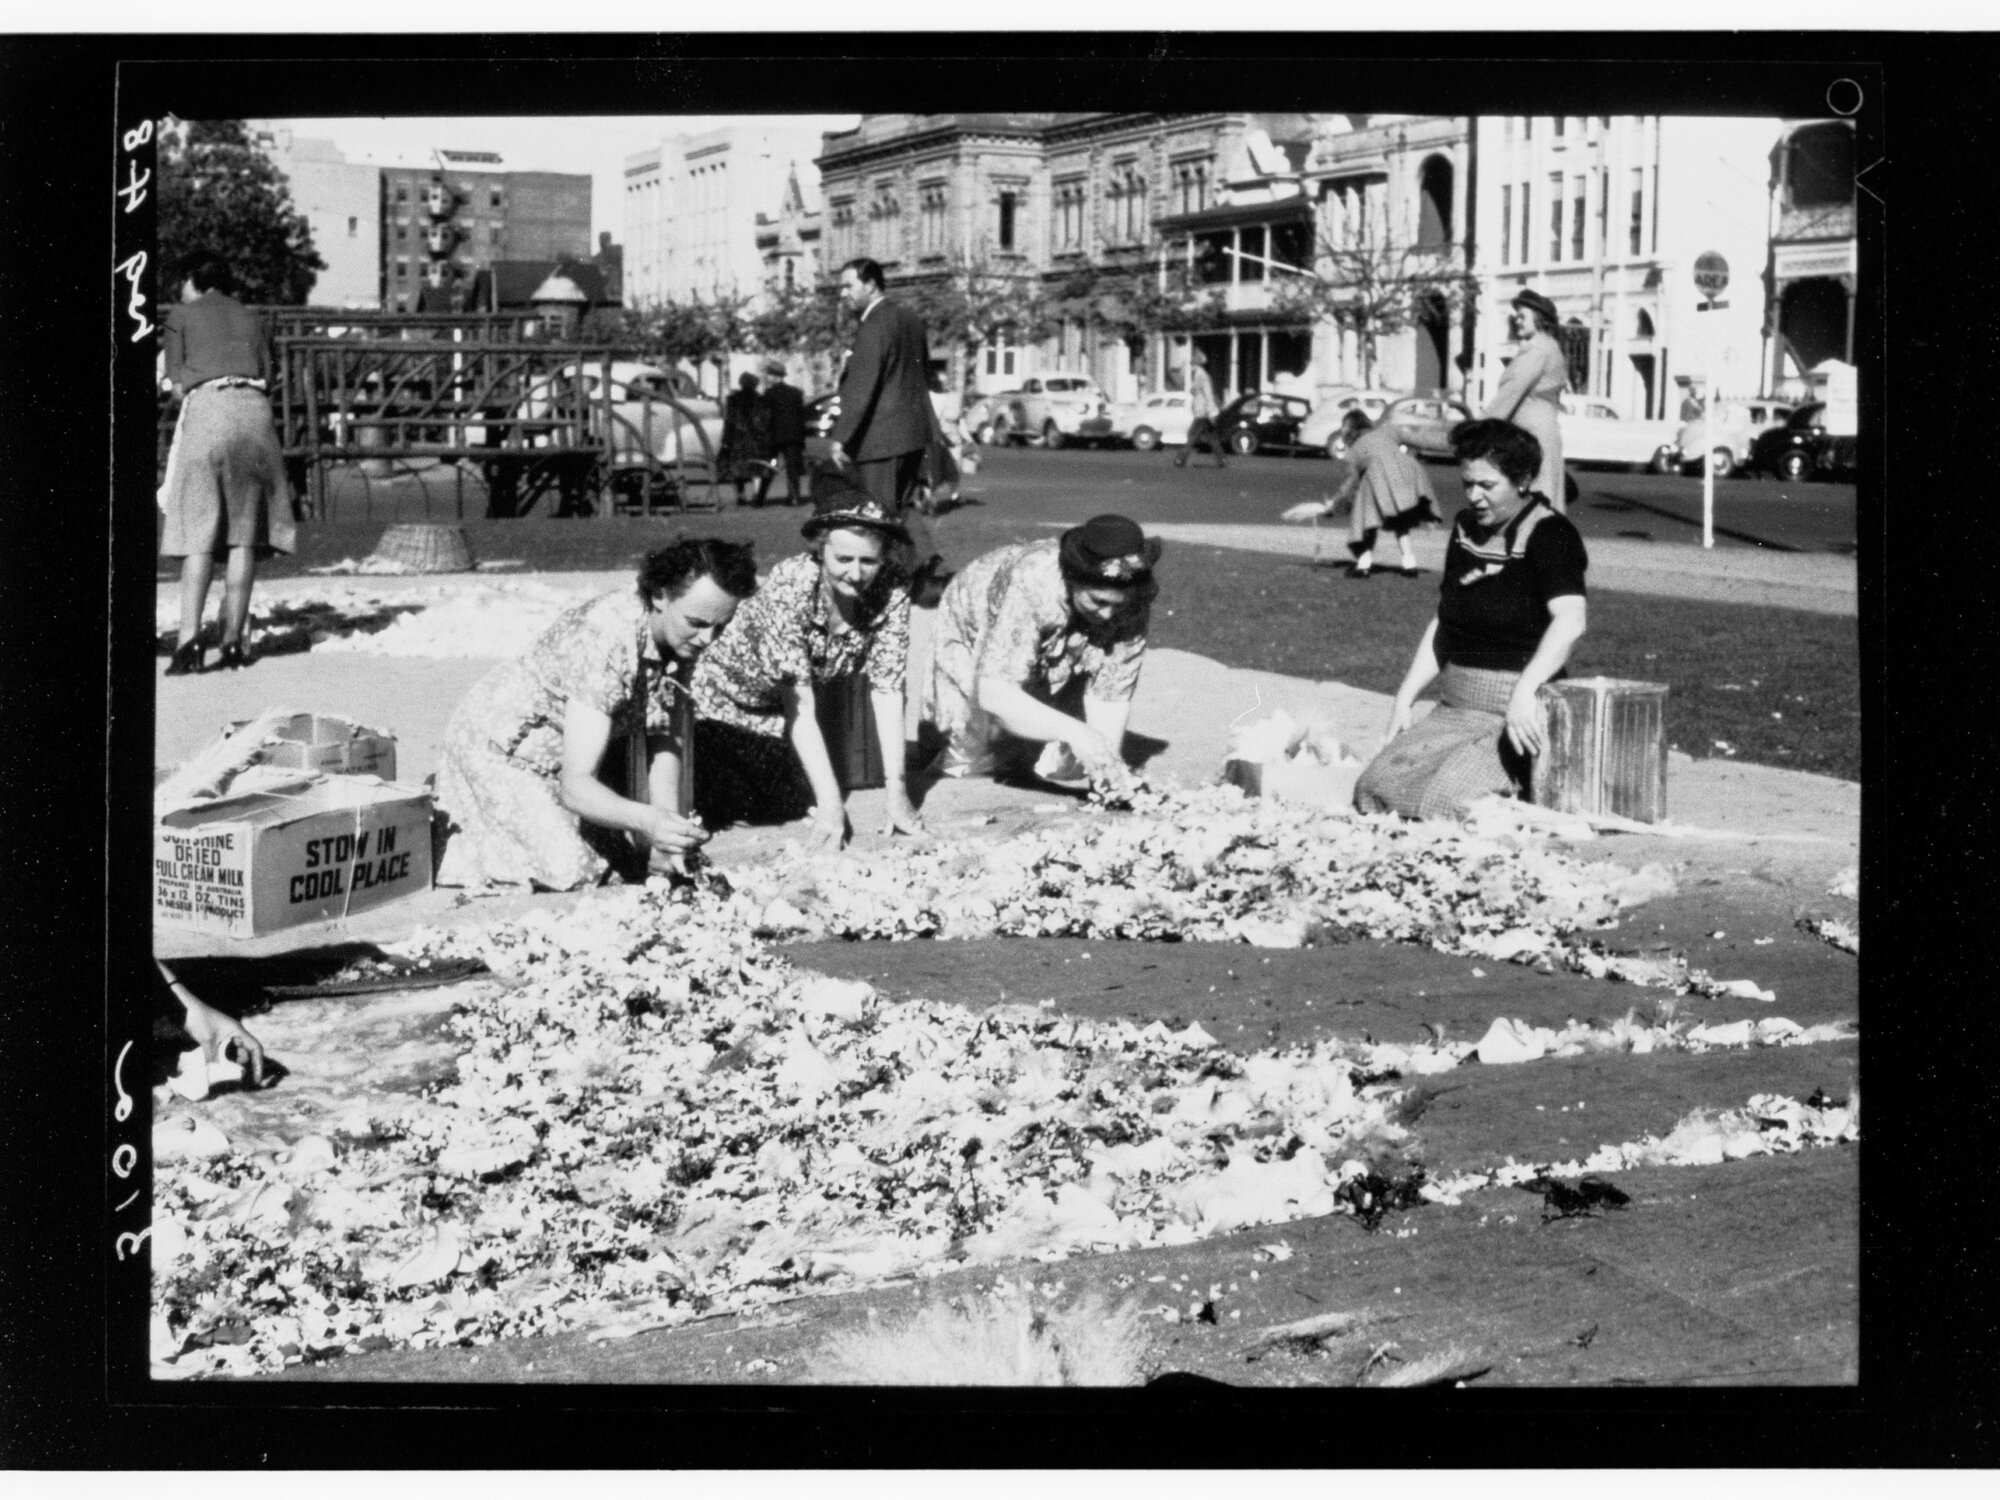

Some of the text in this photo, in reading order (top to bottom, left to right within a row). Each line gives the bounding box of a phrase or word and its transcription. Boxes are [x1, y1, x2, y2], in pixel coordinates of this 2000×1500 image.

[176, 845, 221, 866] DRIED
[306, 826, 396, 868] STOW IN
[181, 863, 214, 883] CREAM
[218, 868, 244, 887] MILK
[290, 851, 410, 904] COOL PLACE
[204, 904, 246, 919] PRODUCT
[218, 894, 245, 909] TINS
